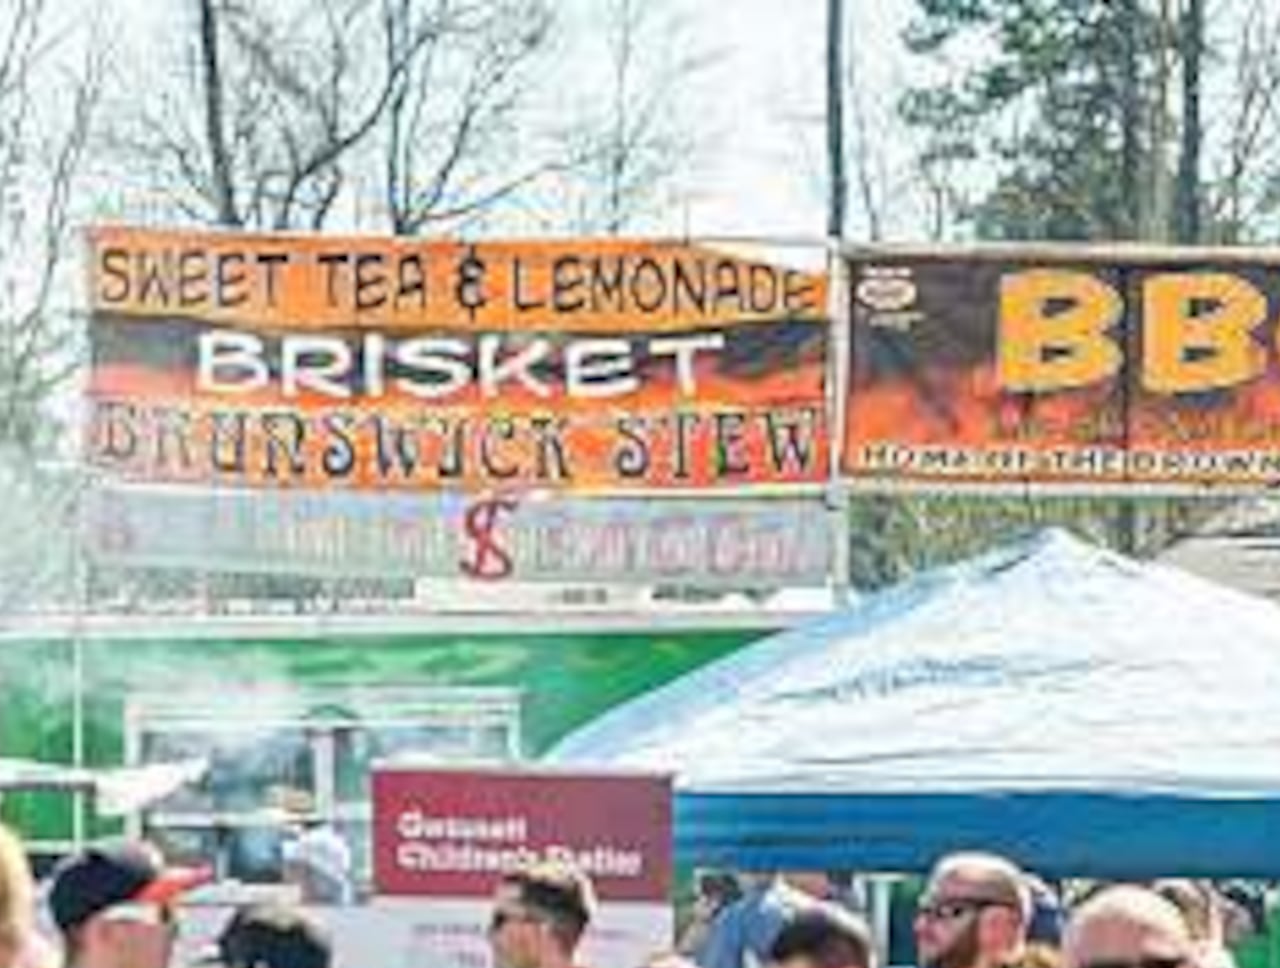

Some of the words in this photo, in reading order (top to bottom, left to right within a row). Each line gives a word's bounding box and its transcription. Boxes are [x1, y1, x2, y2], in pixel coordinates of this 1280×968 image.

[99, 250, 290, 306] SWEET
[319, 252, 425, 310] TEA
[455, 252, 488, 319] &
[514, 252, 819, 315] LEMONADE
[195, 330, 725, 397] BRISKET
[98, 402, 576, 478] BRUNSWICK
[616, 406, 819, 480] STEW
[1052, 448, 1121, 472] THE
